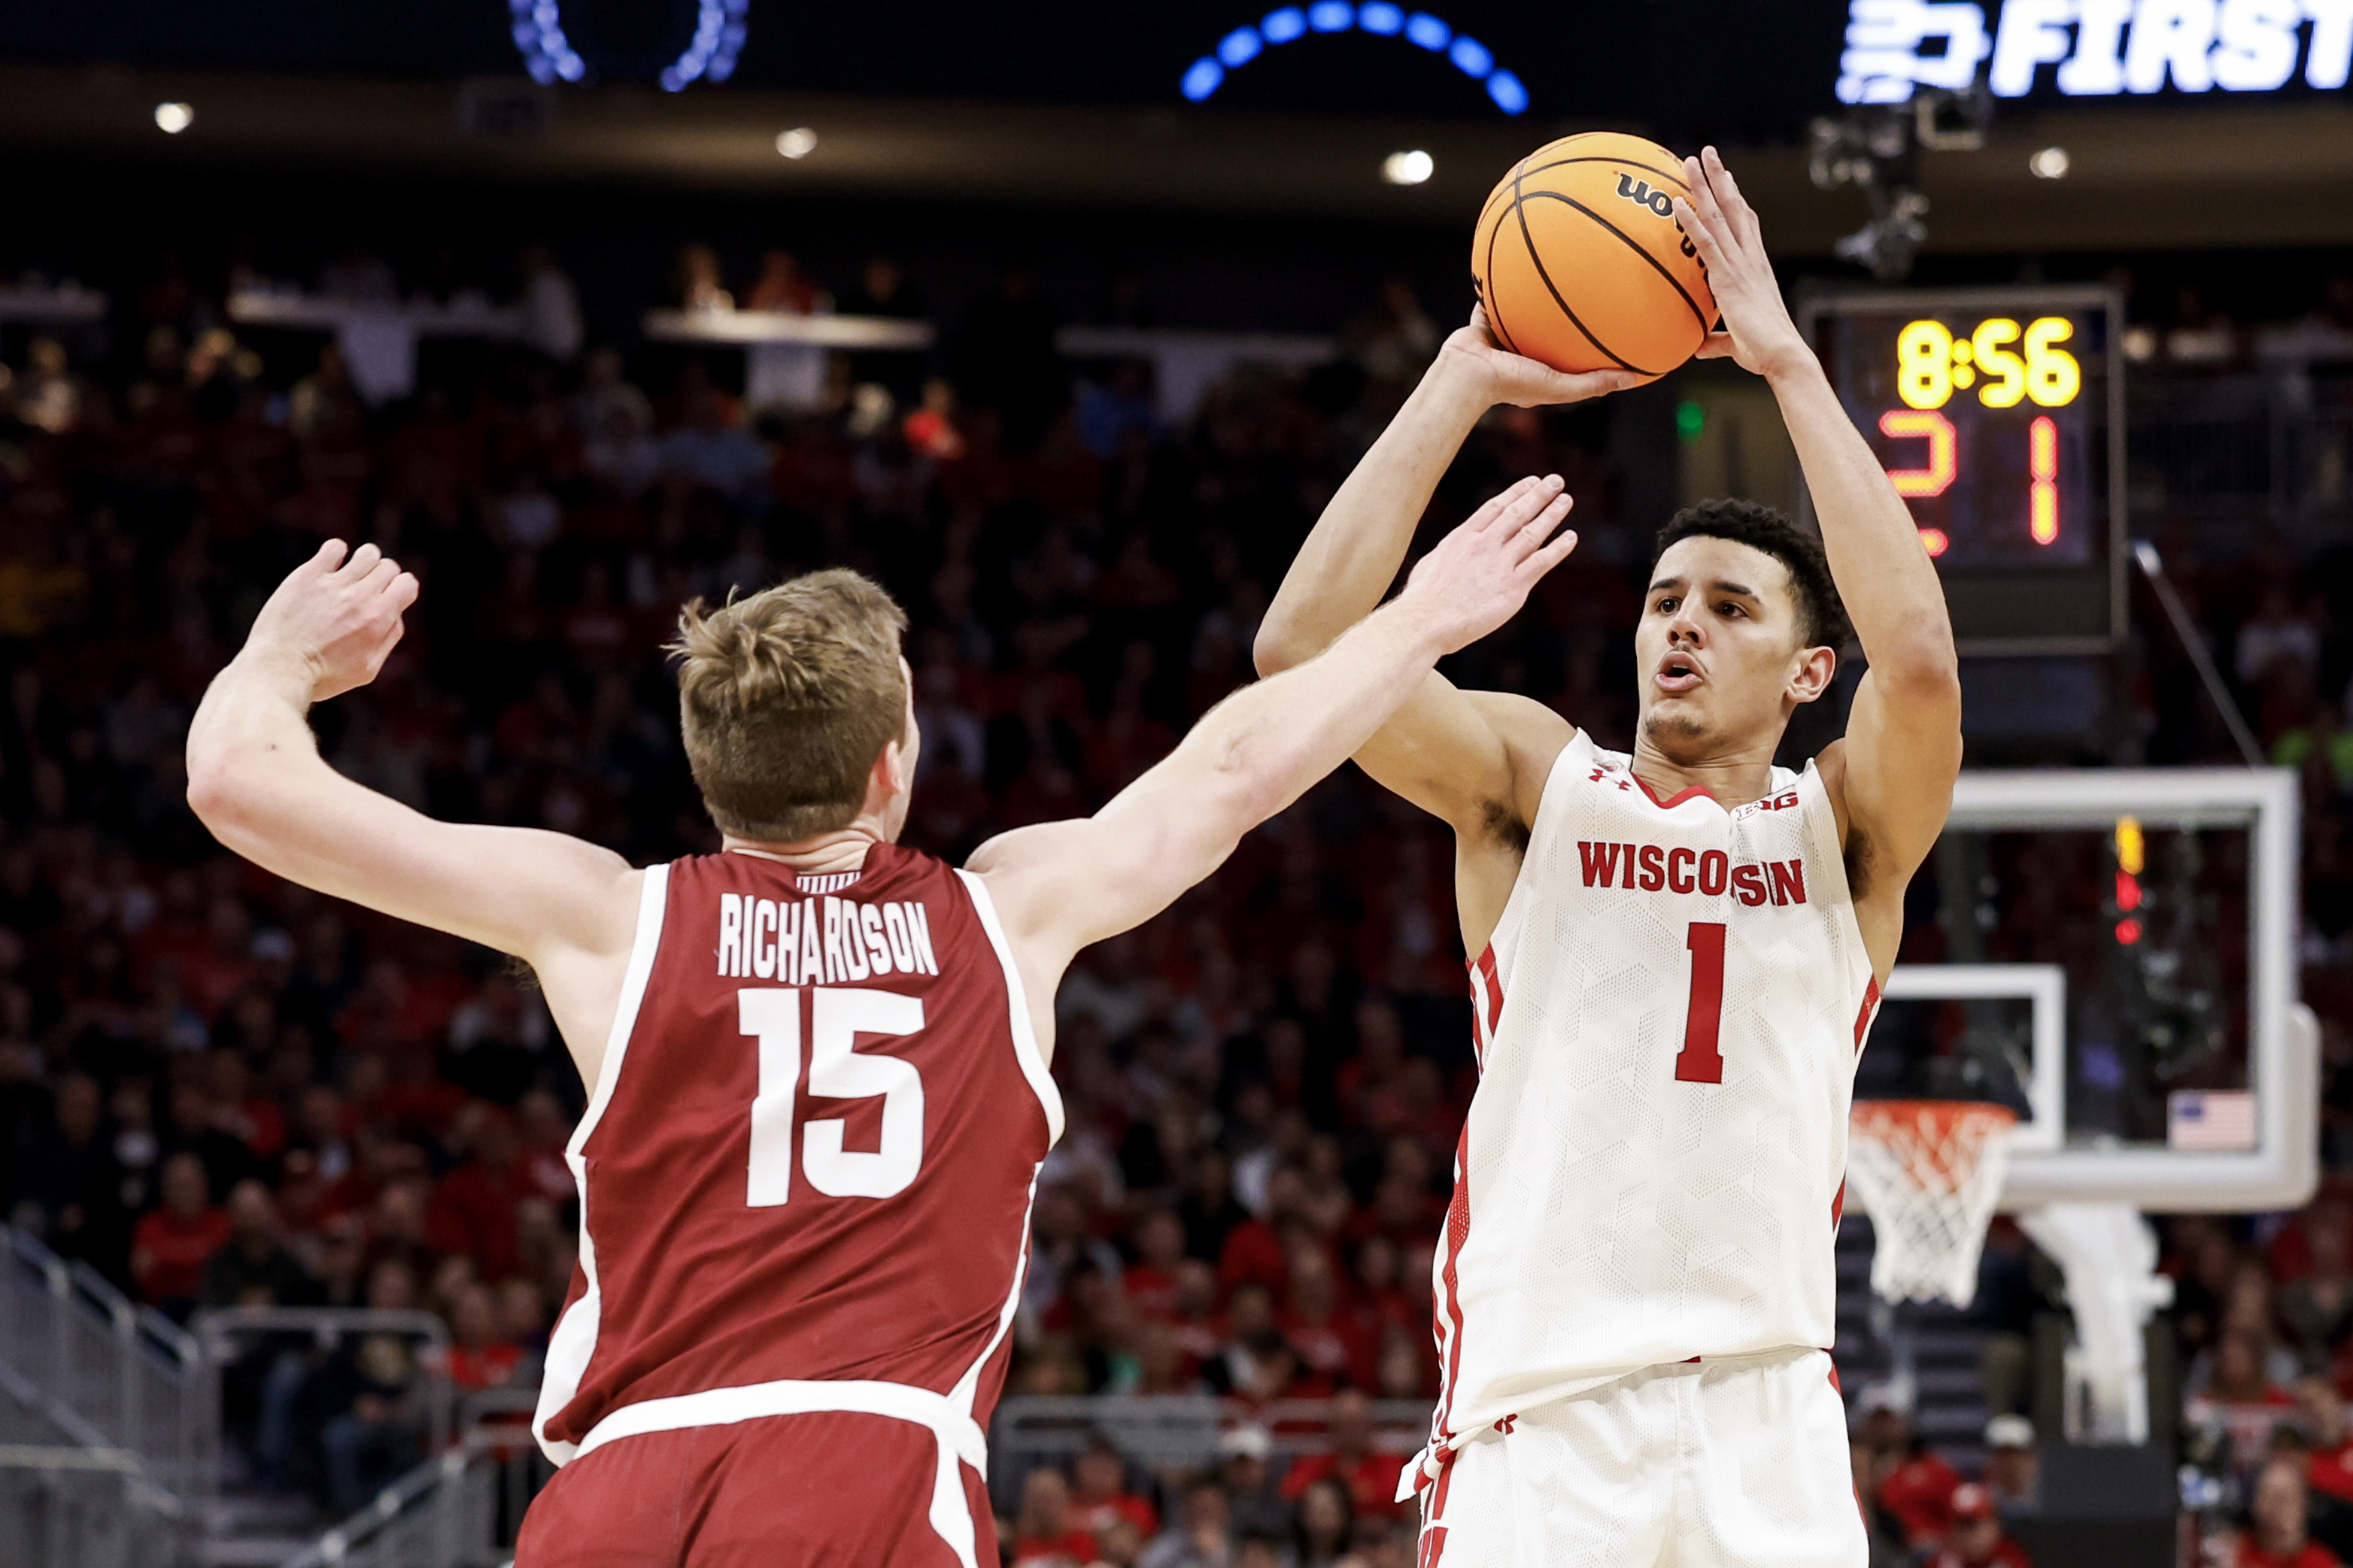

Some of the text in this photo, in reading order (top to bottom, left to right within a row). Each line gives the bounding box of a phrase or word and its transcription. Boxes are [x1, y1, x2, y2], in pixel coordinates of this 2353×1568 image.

[1990, 0, 2353, 97] FIRST
[1897, 317, 2081, 410] 8:56
[1577, 841, 1807, 907] WISCOSN
[717, 893, 940, 986] RICHARDSON
[1674, 922, 1726, 1084] 1
[737, 987, 926, 1208] 15
